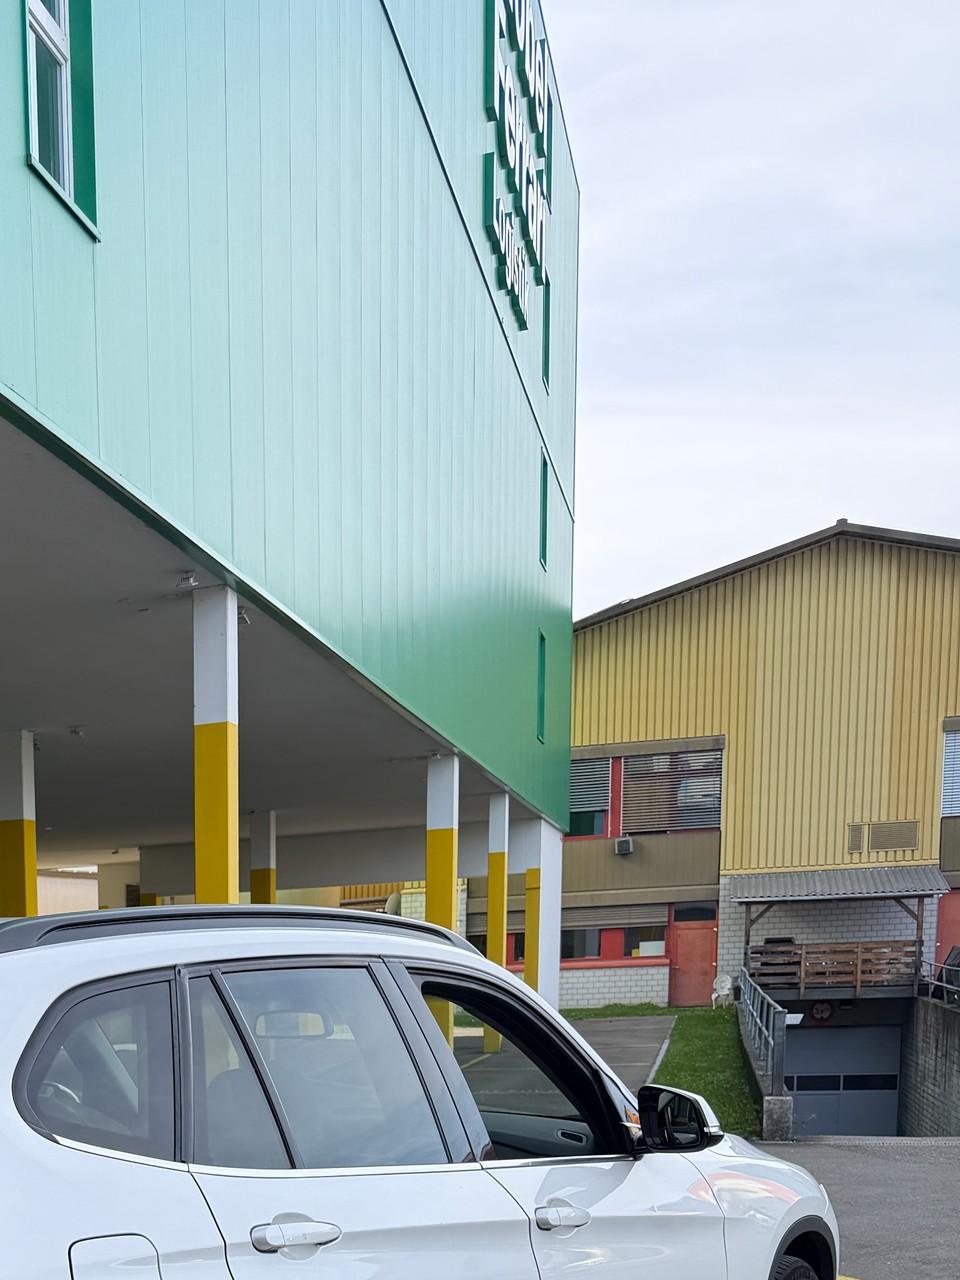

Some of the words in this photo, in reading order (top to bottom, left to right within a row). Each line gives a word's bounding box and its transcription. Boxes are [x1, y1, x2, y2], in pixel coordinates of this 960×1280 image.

[494, 0, 547, 285] Ferrari
[508, 0, 547, 158] bel
[493, 152, 529, 330] Logistik
